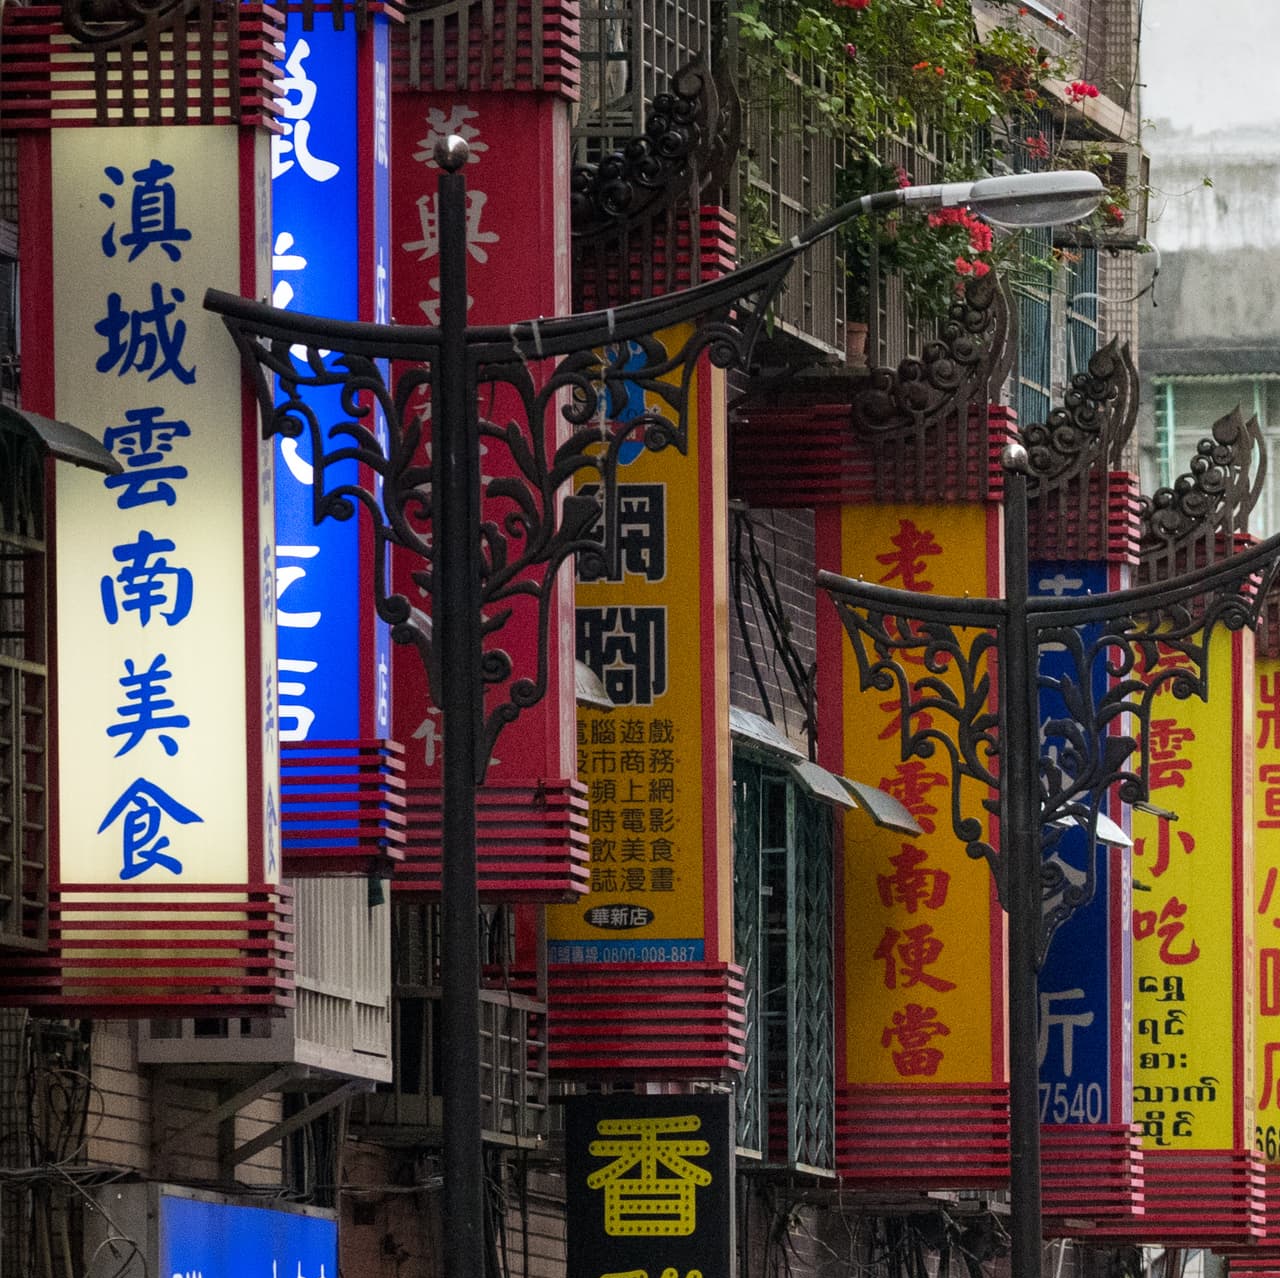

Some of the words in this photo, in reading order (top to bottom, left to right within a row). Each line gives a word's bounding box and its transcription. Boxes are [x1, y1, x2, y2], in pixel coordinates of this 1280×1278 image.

[95, 158, 205, 880] 滇城雲南美食
[583, 778, 675, 804] 頻上網
[585, 808, 675, 833] 時電影
[586, 838, 676, 863] 飲美食
[590, 867, 676, 893] 誌漫畫
[591, 907, 649, 926] 華新店
